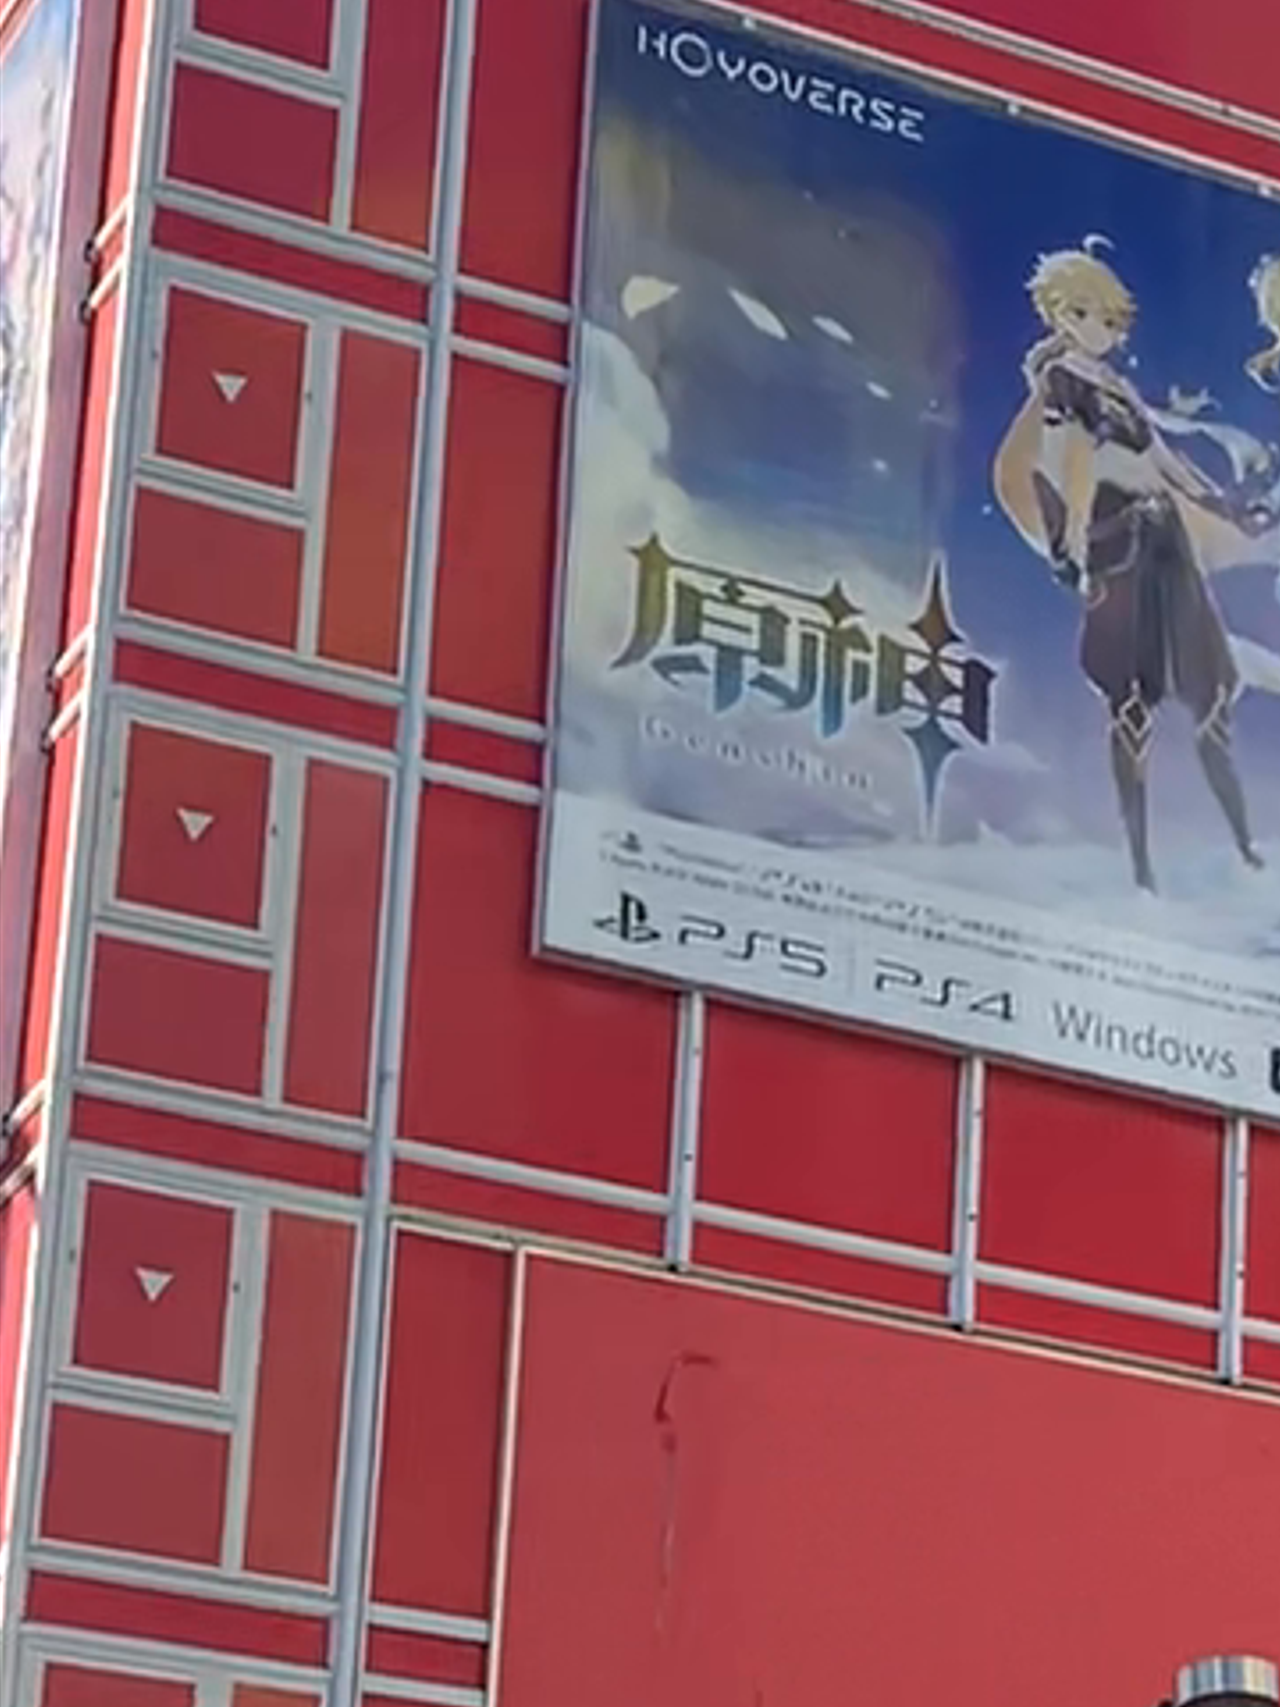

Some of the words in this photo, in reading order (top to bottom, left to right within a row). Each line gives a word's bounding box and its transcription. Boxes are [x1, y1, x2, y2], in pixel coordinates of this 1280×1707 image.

[637, 25, 925, 142] HOYOVERSE
[677, 913, 829, 980] PS5
[874, 960, 1015, 1022] PS4
[1051, 999, 1239, 1081] Windows
